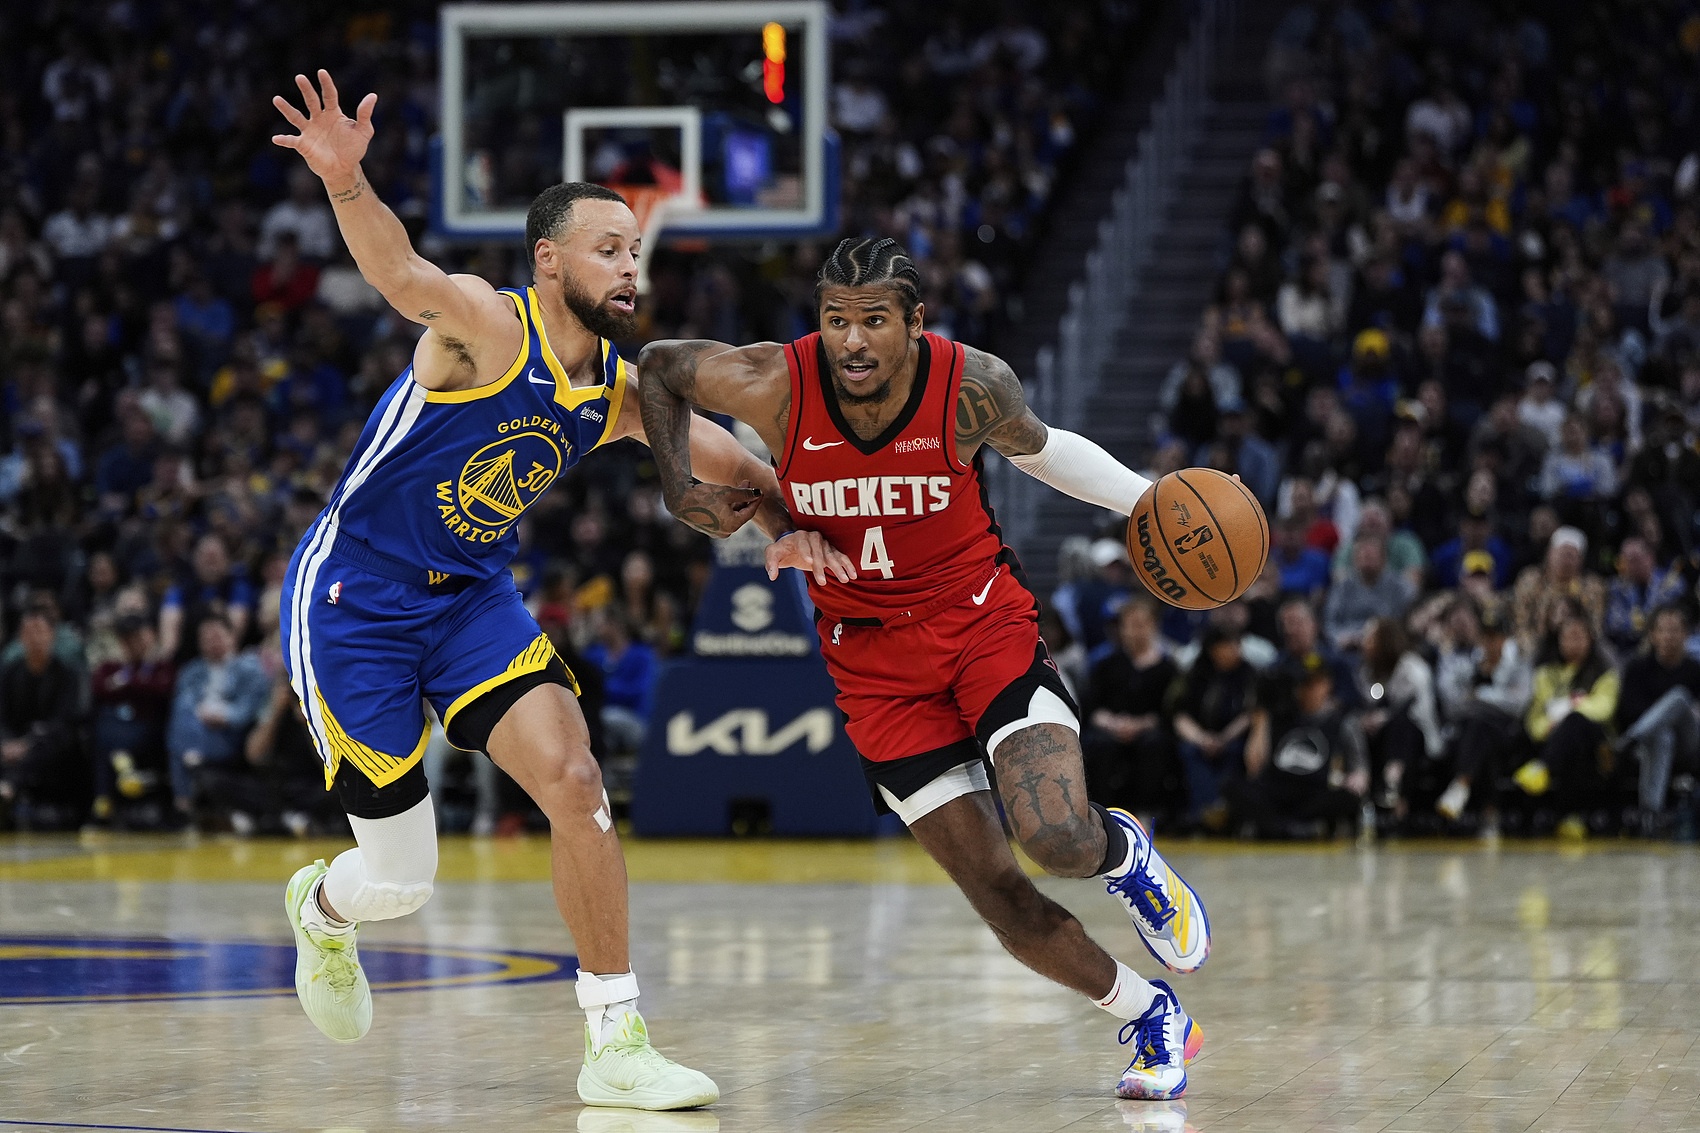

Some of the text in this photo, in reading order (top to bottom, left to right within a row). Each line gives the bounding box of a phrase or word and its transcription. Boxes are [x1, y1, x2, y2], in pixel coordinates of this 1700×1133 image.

[497, 415, 561, 435] GOLDEN
[895, 437, 939, 449] MEMORIAL
[895, 441, 940, 454] HERMANN
[517, 461, 554, 493] 30
[789, 476, 951, 517] ROCKETS
[860, 525, 895, 580] 4
[1137, 511, 1187, 602] Wilson
[427, 569, 450, 585] W
[666, 708, 835, 757] KIA
